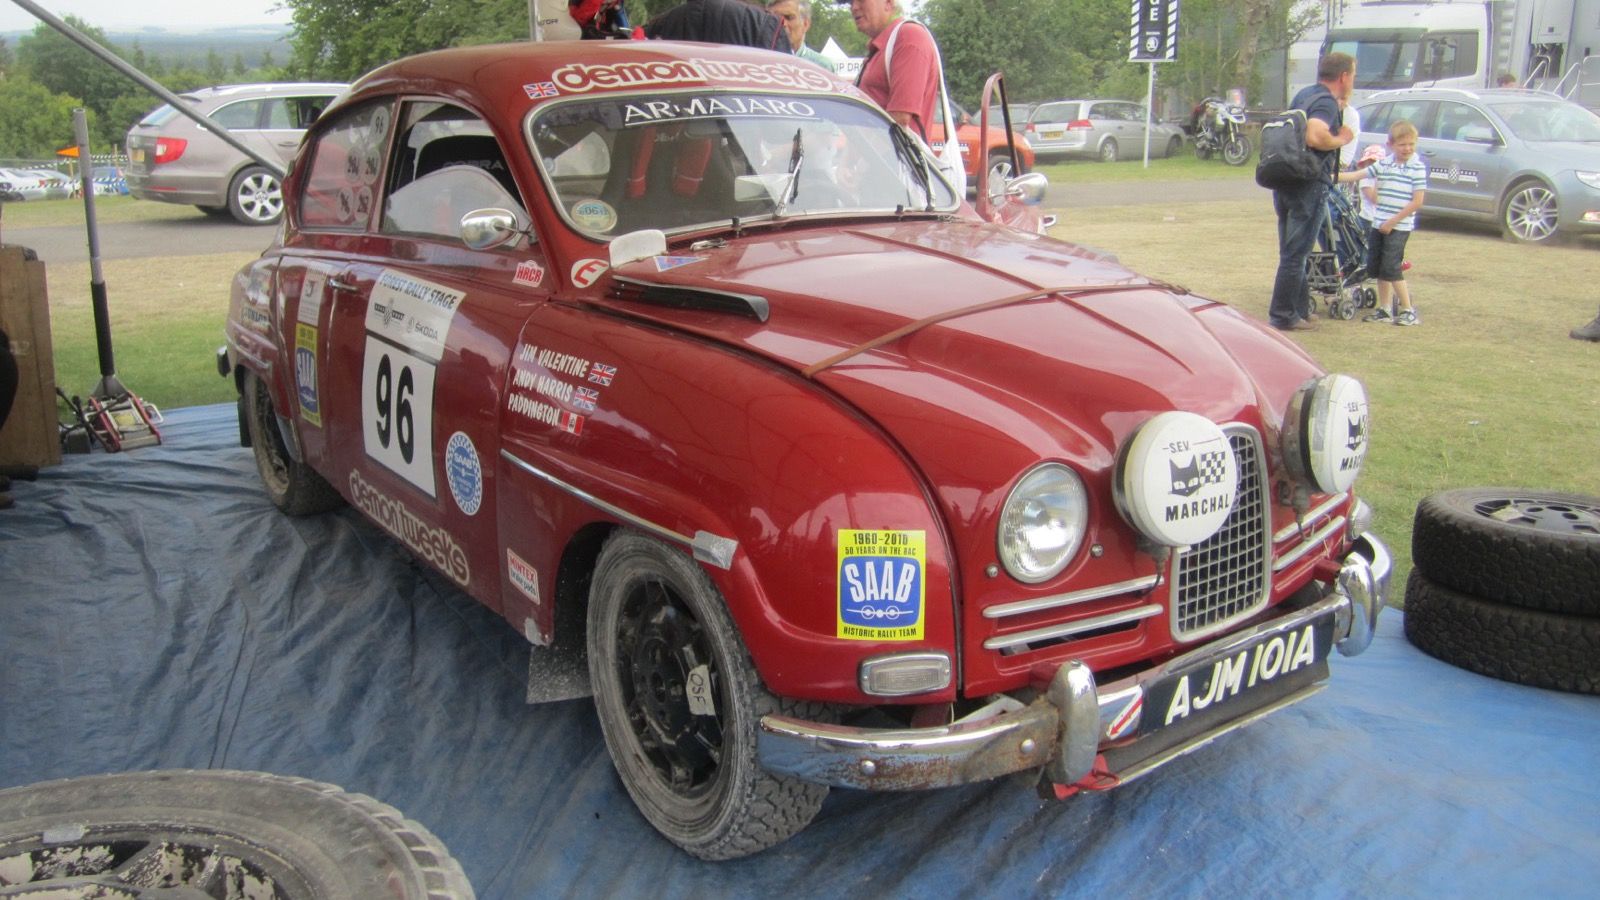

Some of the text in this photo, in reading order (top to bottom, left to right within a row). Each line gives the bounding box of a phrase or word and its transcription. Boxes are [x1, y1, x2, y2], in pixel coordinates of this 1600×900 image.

[517, 265, 543, 283] HRCR
[405, 281, 431, 300] RALLY
[428, 289, 458, 310] STAGE
[519, 343, 590, 378] JIM VALENTINE
[512, 368, 574, 402] ANDY HARRIS
[376, 353, 414, 465] 96
[507, 393, 560, 427] PADDINGTON
[1165, 493, 1230, 522] MARCHAL
[845, 546, 855, 555] 50
[856, 546, 876, 555] YEARS
[878, 546, 888, 555] ON
[890, 546, 901, 556] THE
[844, 560, 916, 604] SAAB
[843, 626, 917, 638] HISTORIC RALLY TEAM
[1164, 650, 1248, 726] AJM
